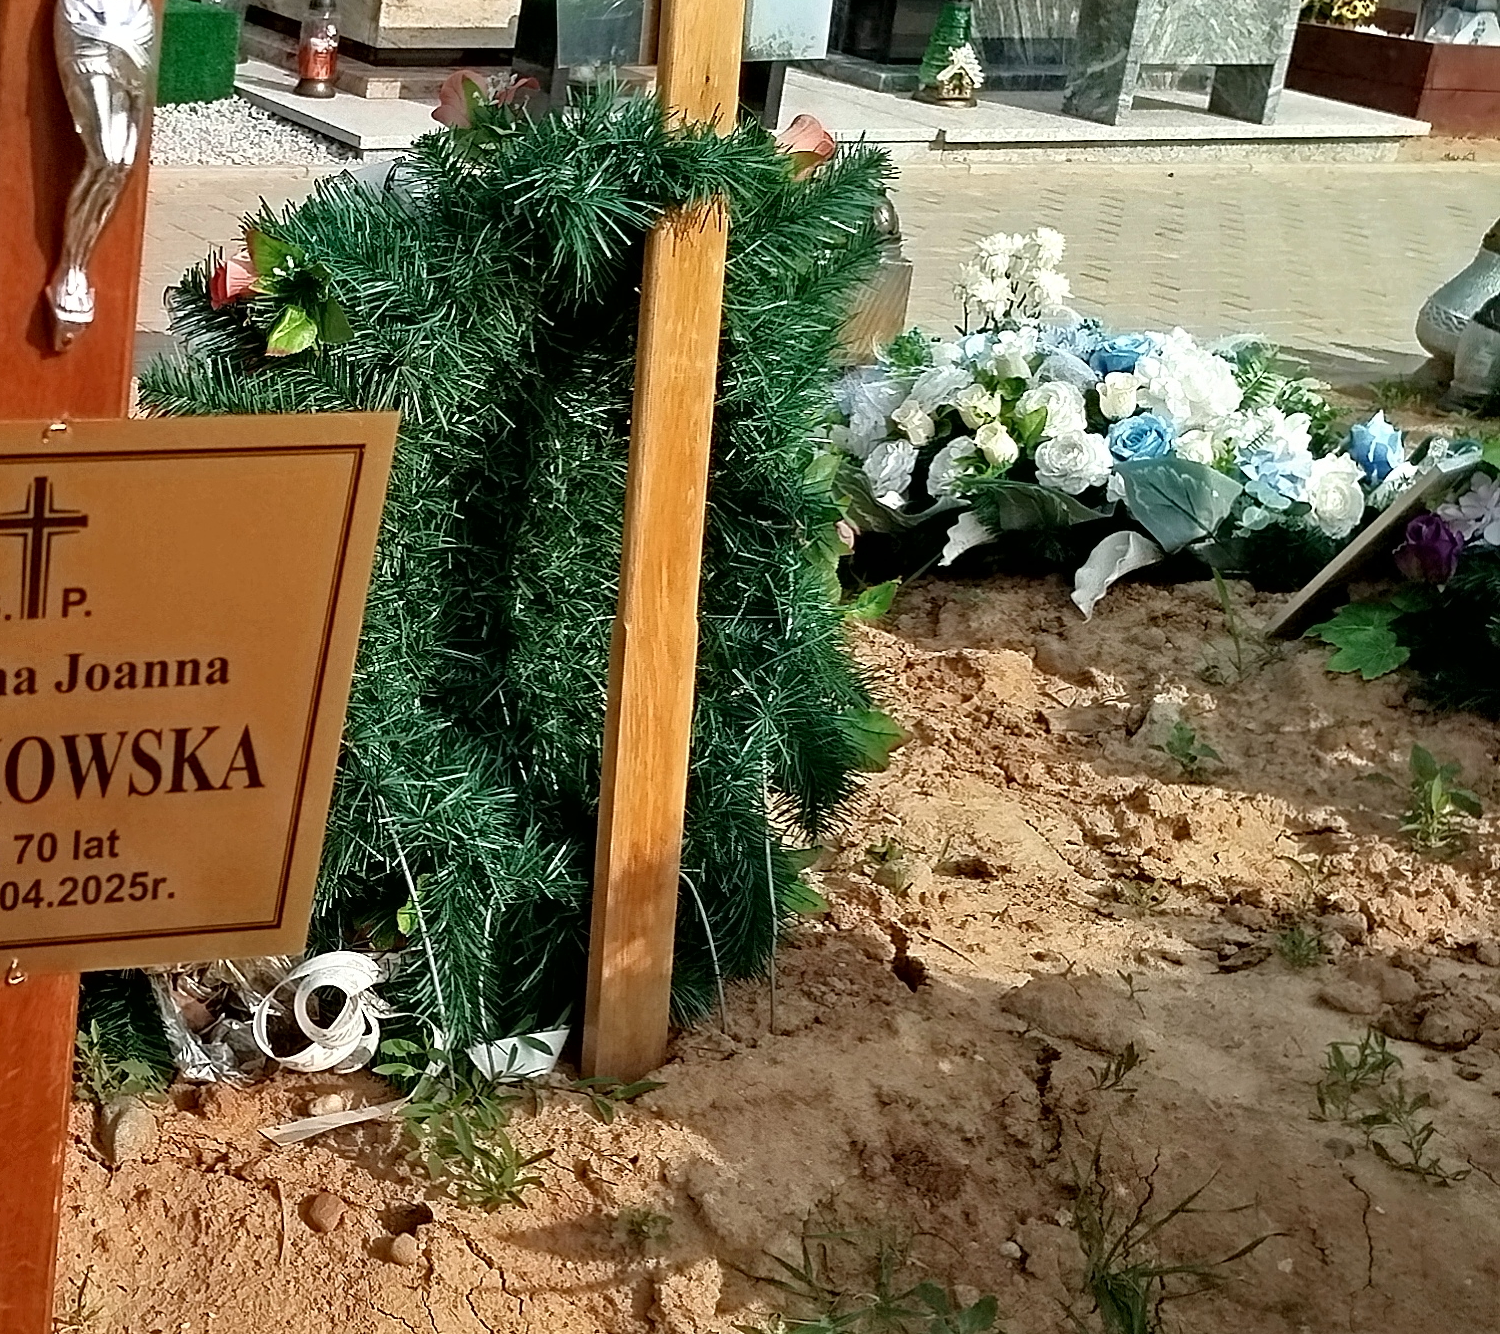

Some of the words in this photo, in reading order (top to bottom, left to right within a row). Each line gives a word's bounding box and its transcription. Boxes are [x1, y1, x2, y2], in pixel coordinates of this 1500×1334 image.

[61, 587, 93, 619] P.
[54, 652, 231, 695] Joanna
[13, 831, 58, 866] 70
[72, 829, 121, 860] lat
